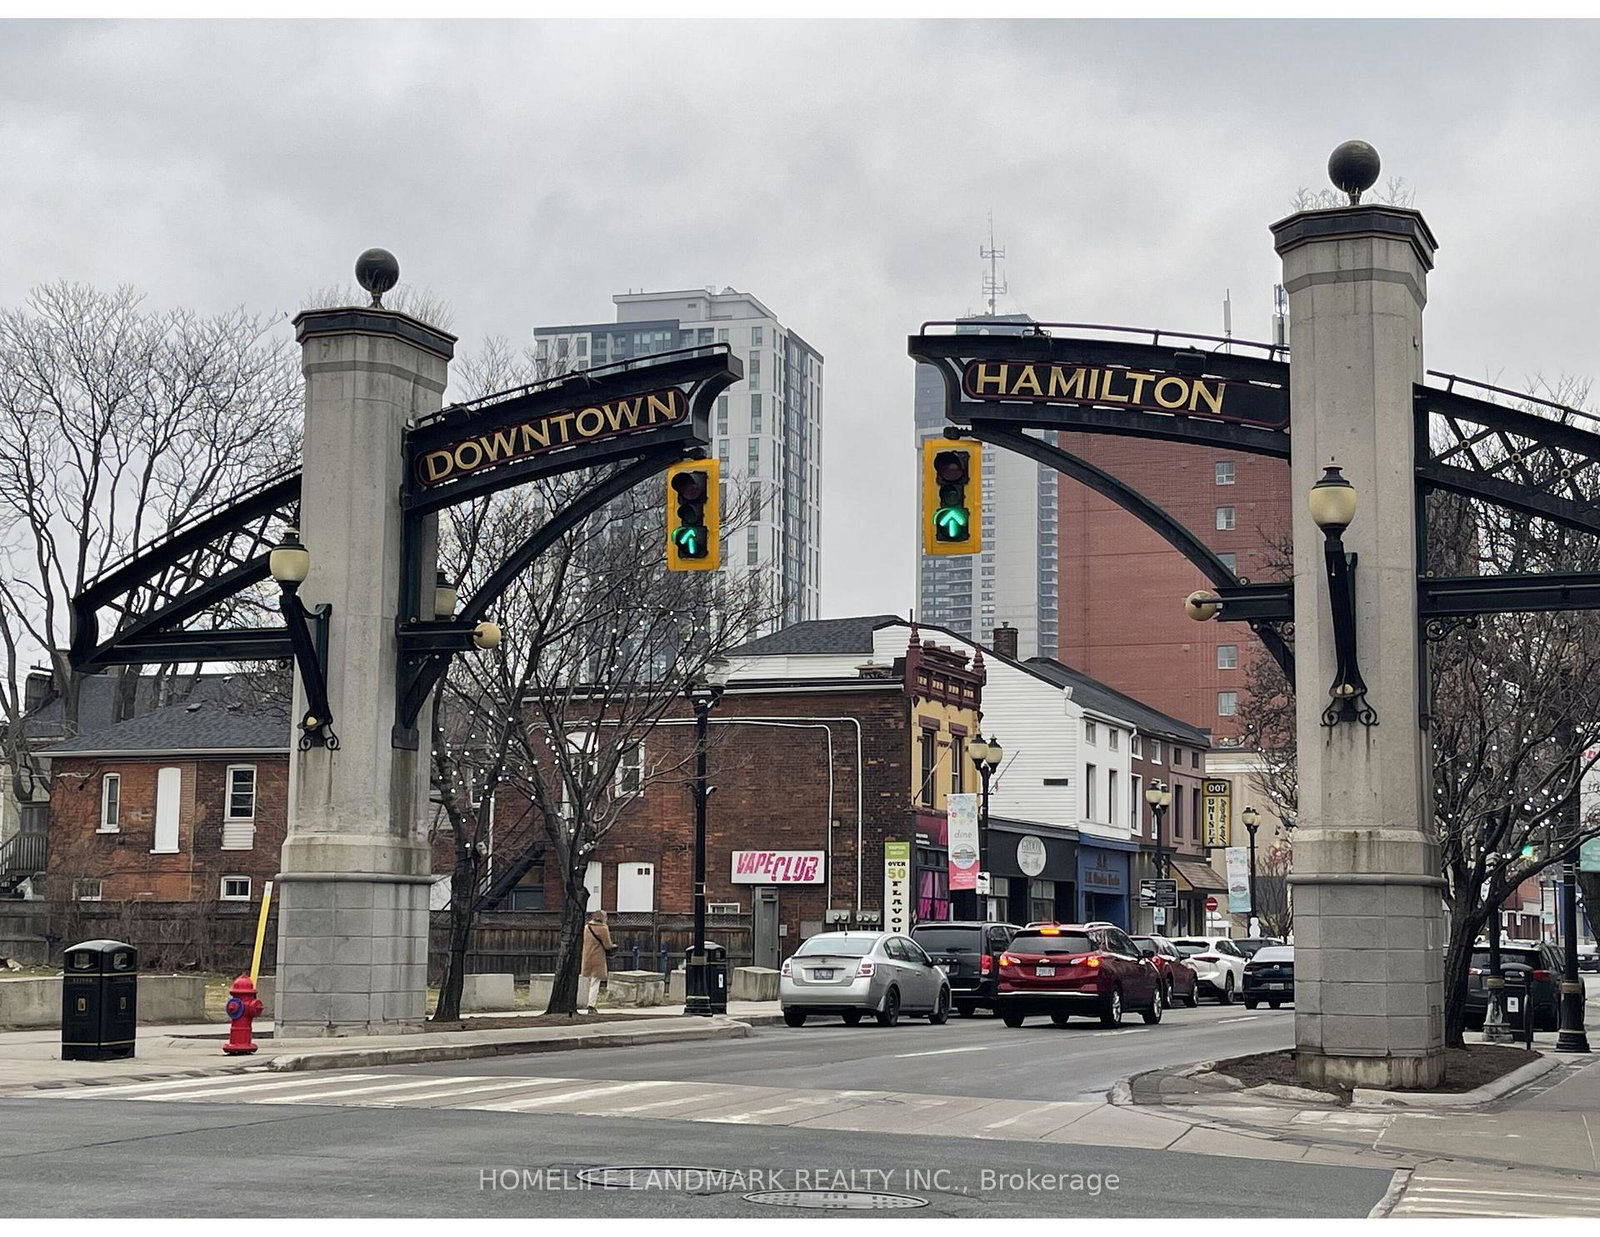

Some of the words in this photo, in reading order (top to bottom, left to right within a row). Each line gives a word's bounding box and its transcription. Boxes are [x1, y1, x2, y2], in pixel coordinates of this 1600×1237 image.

[976, 364, 1226, 413] HAMILTON
[426, 391, 678, 481] DOWNTOWN
[1208, 784, 1226, 793] 007
[888, 868, 906, 879] 50
